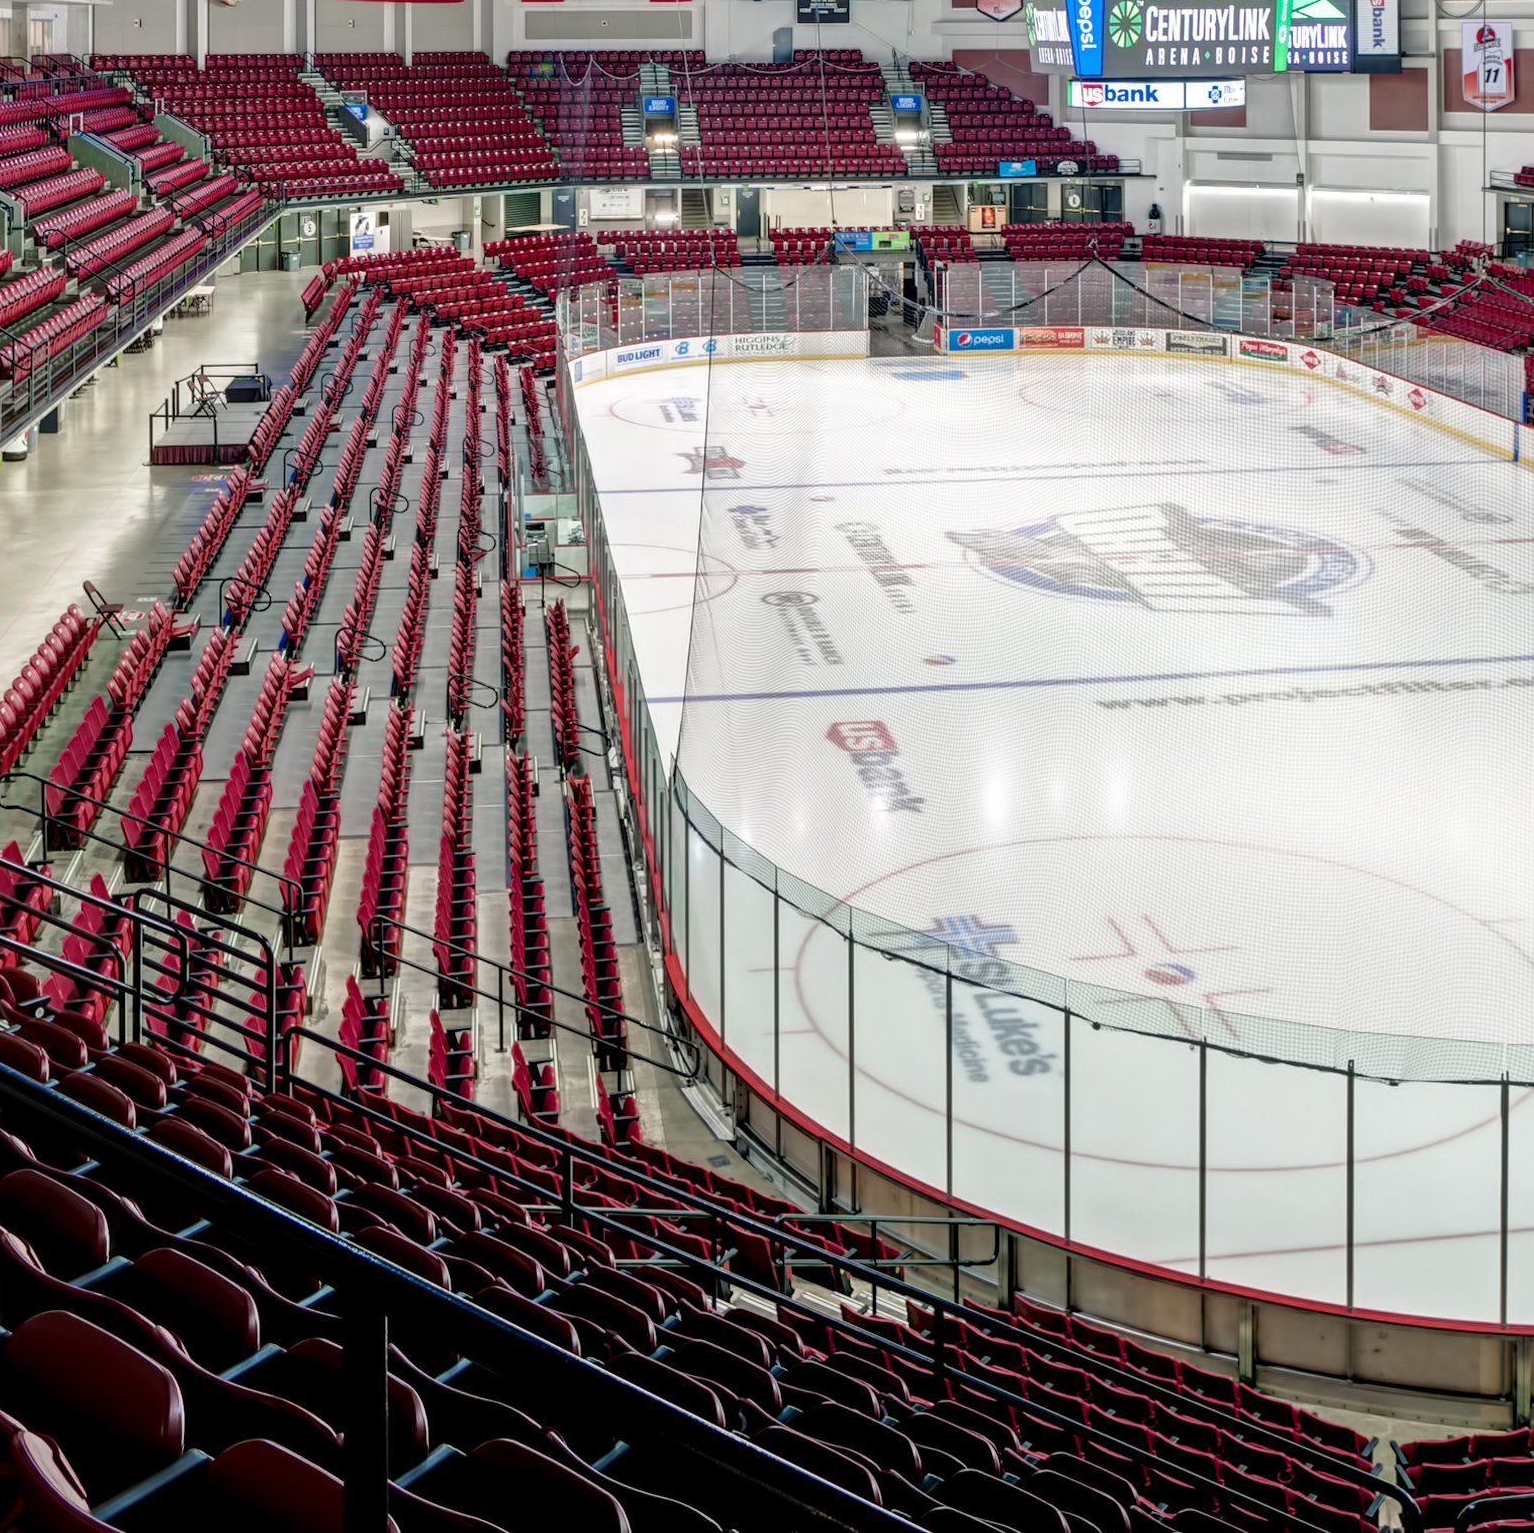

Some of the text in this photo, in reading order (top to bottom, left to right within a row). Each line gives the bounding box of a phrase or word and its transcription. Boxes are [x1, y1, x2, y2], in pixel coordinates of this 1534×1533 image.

[1146, 5, 1271, 43] CENTURYLINK
[1145, 46, 1270, 66] ARENA BOISE
[1309, 51, 1348, 65] BOISE
[1484, 68, 1500, 83] 11
[735, 336, 780, 344] HIGGINS
[735, 342, 788, 352] RUTLEDGE
[974, 334, 1004, 346] pepsi
[1112, 337, 1136, 347] EMPIRE
[617, 348, 660, 363] BUD LIGHT
[974, 990, 1059, 1078] Luke's
